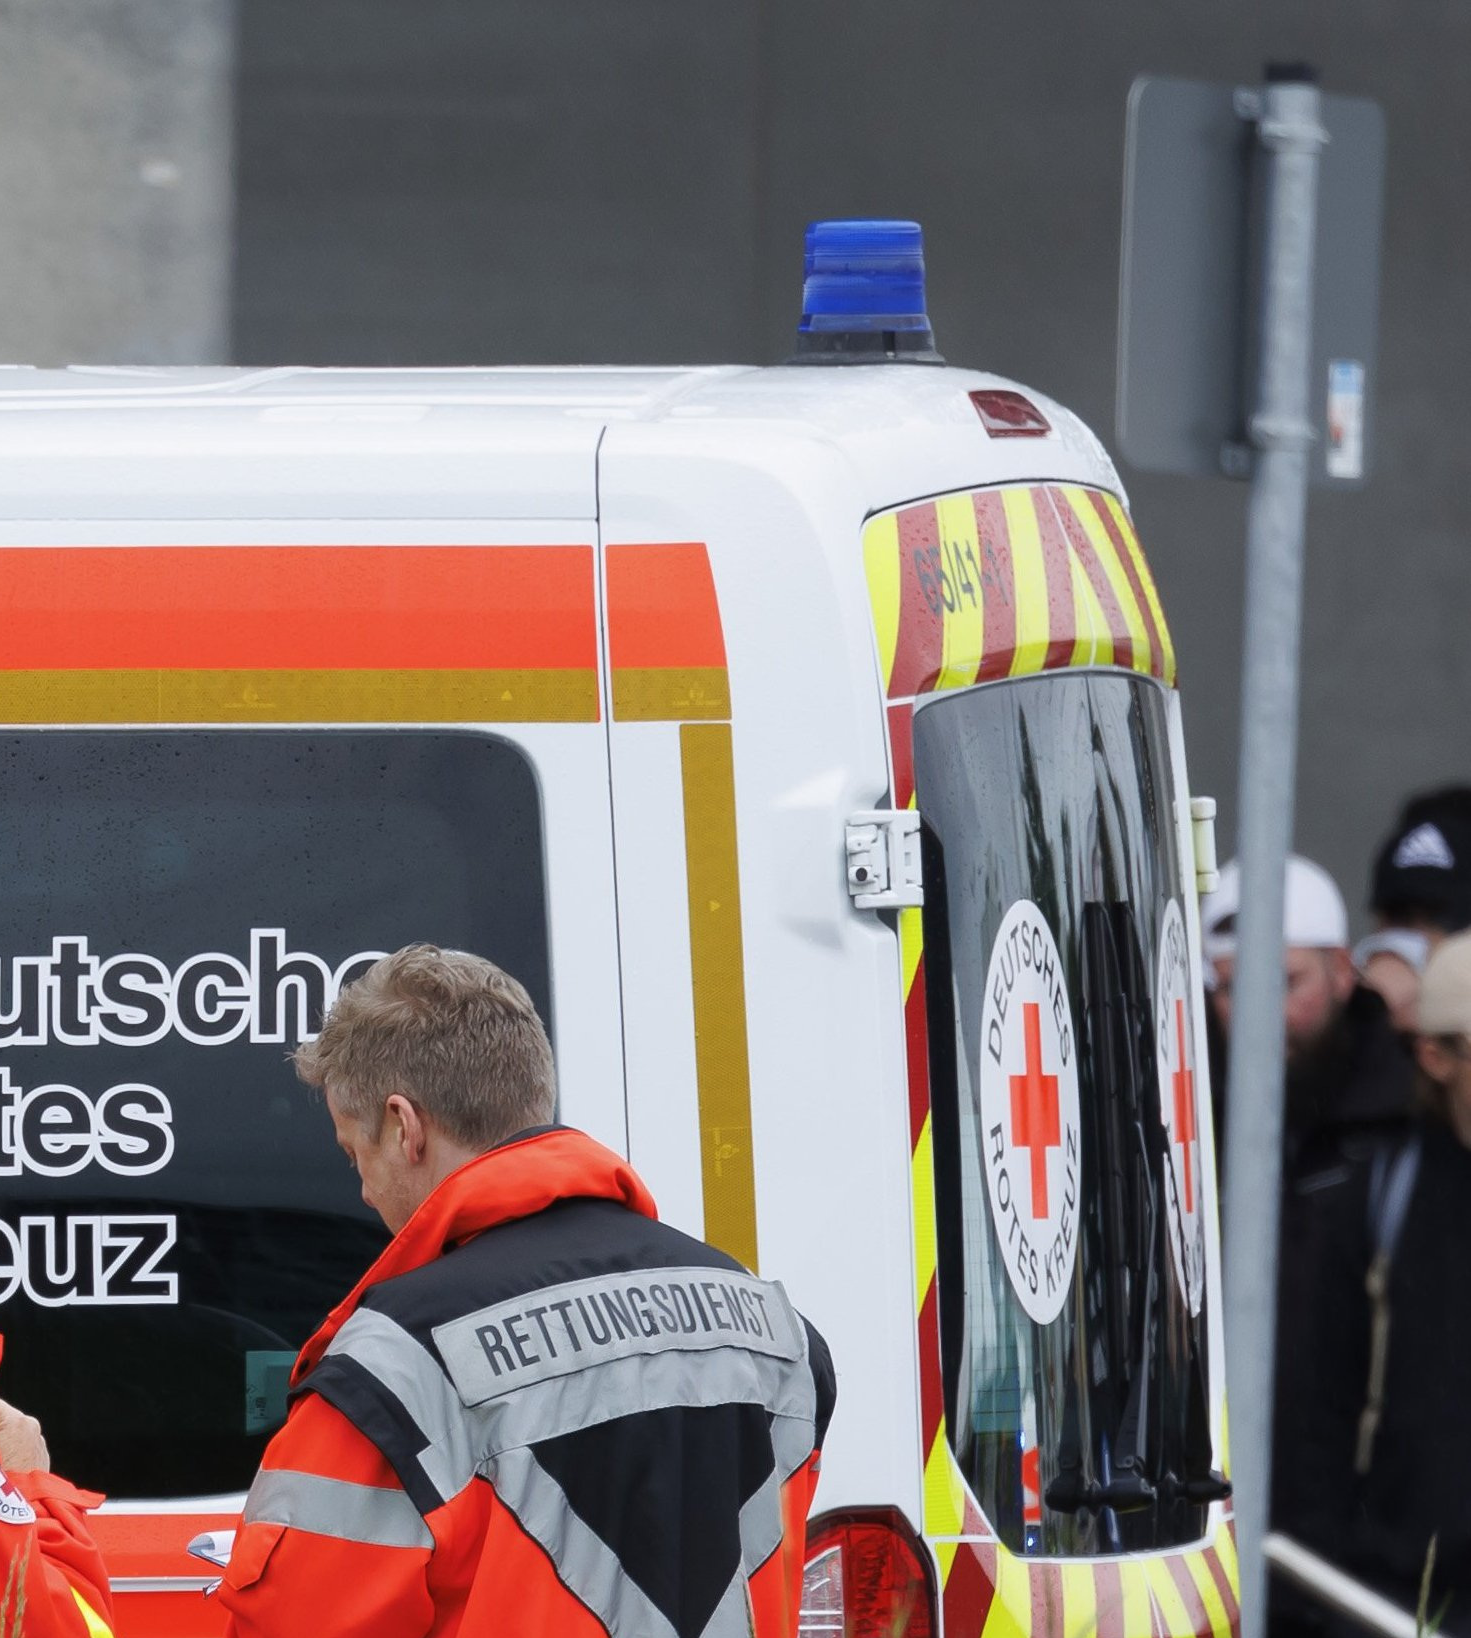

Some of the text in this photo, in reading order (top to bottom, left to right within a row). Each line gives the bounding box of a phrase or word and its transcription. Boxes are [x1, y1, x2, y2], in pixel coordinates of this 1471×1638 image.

[914, 540, 1009, 618] 65/41-1
[988, 920, 1071, 1068] DEUTSCHES
[990, 1122, 1039, 1295] ROTES
[1044, 1122, 1077, 1298] KREUZ
[475, 1282, 776, 1377] RETTUNGSDIENST
